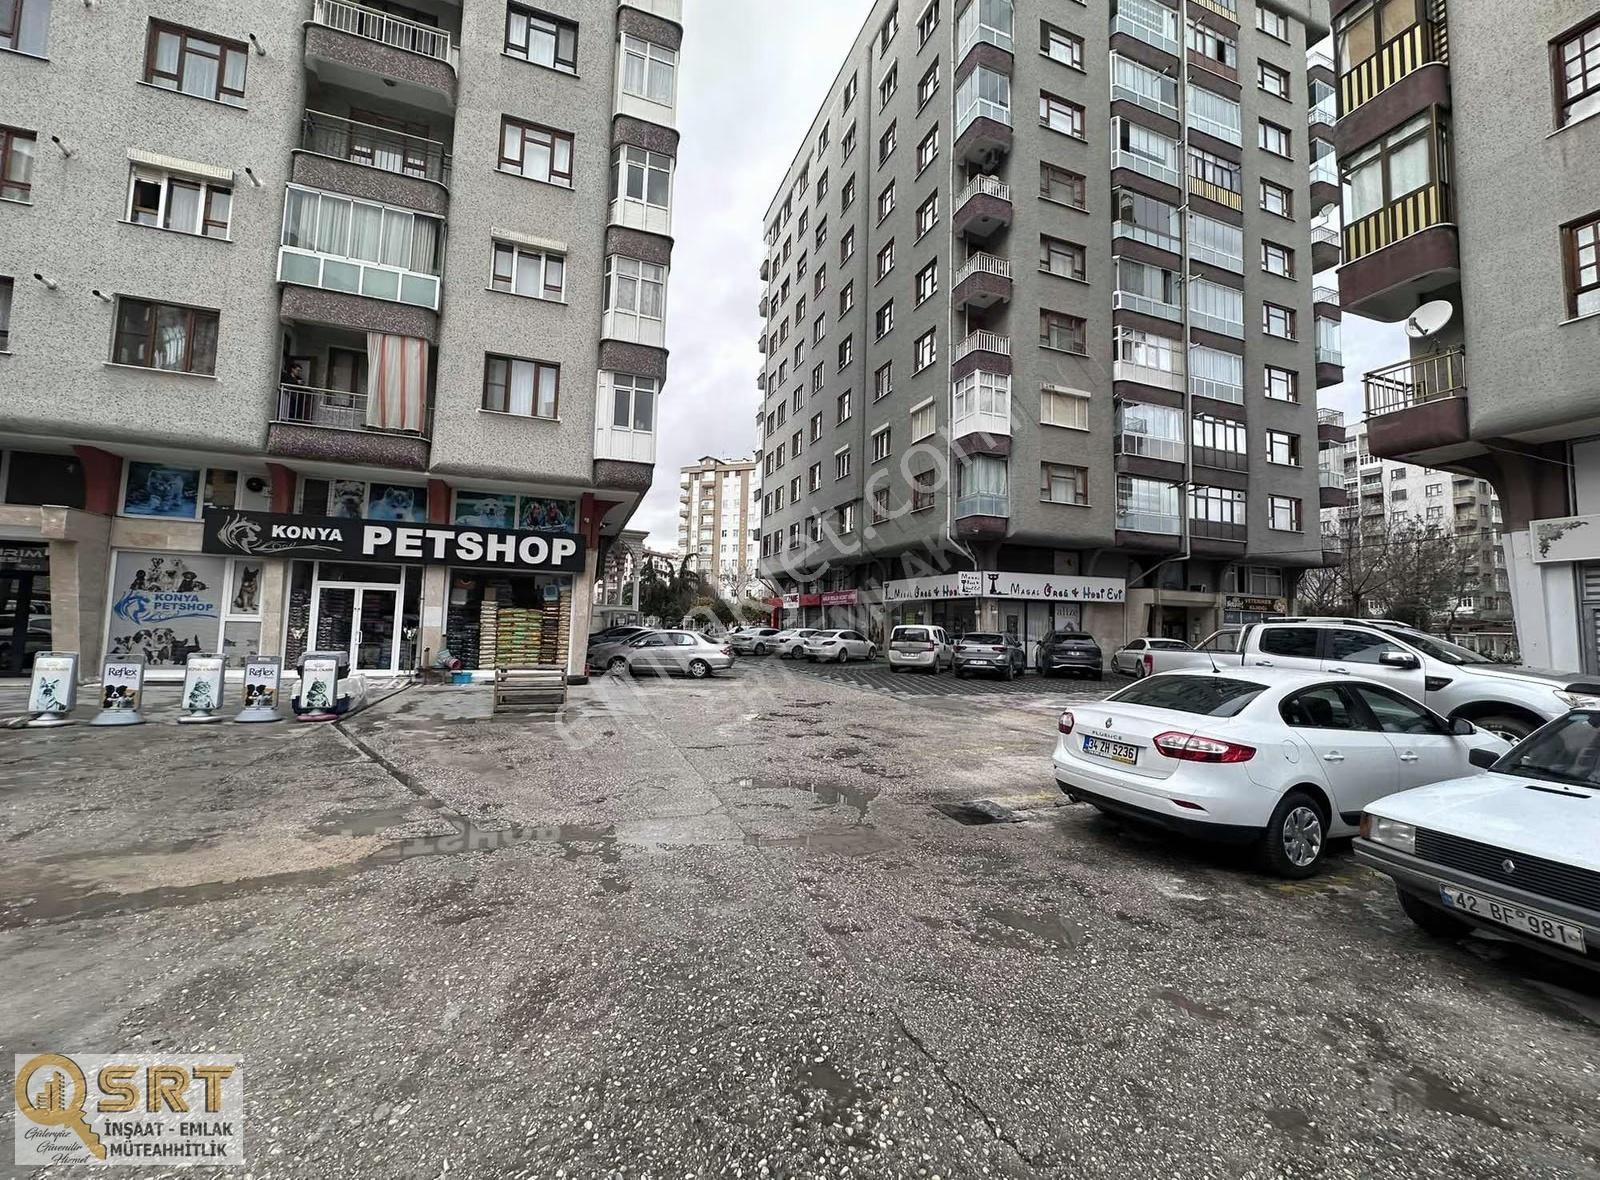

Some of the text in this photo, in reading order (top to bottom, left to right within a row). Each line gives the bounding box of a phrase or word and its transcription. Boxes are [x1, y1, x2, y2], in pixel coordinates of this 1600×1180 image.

[271, 524, 577, 565] KONYA PETSHOP
[153, 593, 199, 602] KONYA
[153, 602, 213, 611] PETSHOP
[108, 667, 137, 677] Reflex
[249, 667, 275, 677] Reflex
[1088, 739, 1134, 759] 34 ZH 5236
[1456, 892, 1568, 944] 42 BF 981
